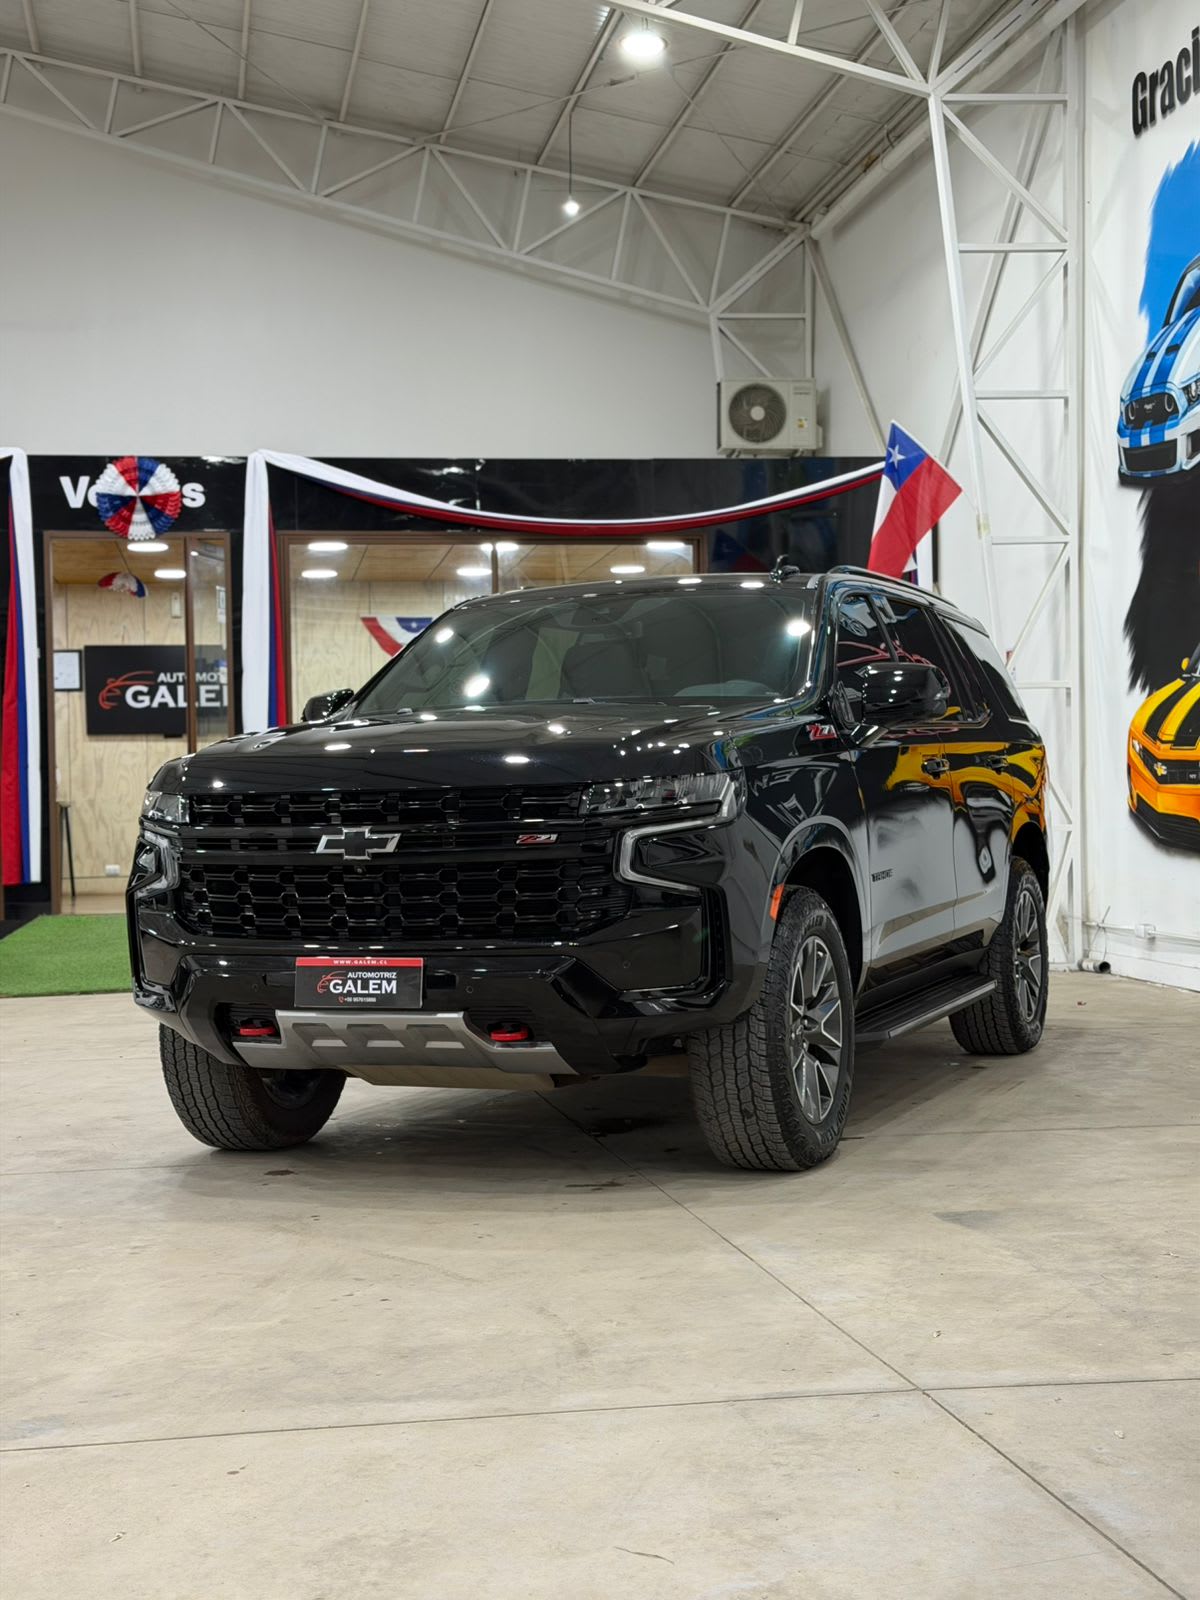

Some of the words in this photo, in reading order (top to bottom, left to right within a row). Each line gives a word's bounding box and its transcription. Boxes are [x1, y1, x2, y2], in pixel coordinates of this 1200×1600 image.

[125, 685, 228, 708] GALE
[347, 971, 397, 979] AUTOMOTRIZ
[329, 979, 397, 994] GALEM
